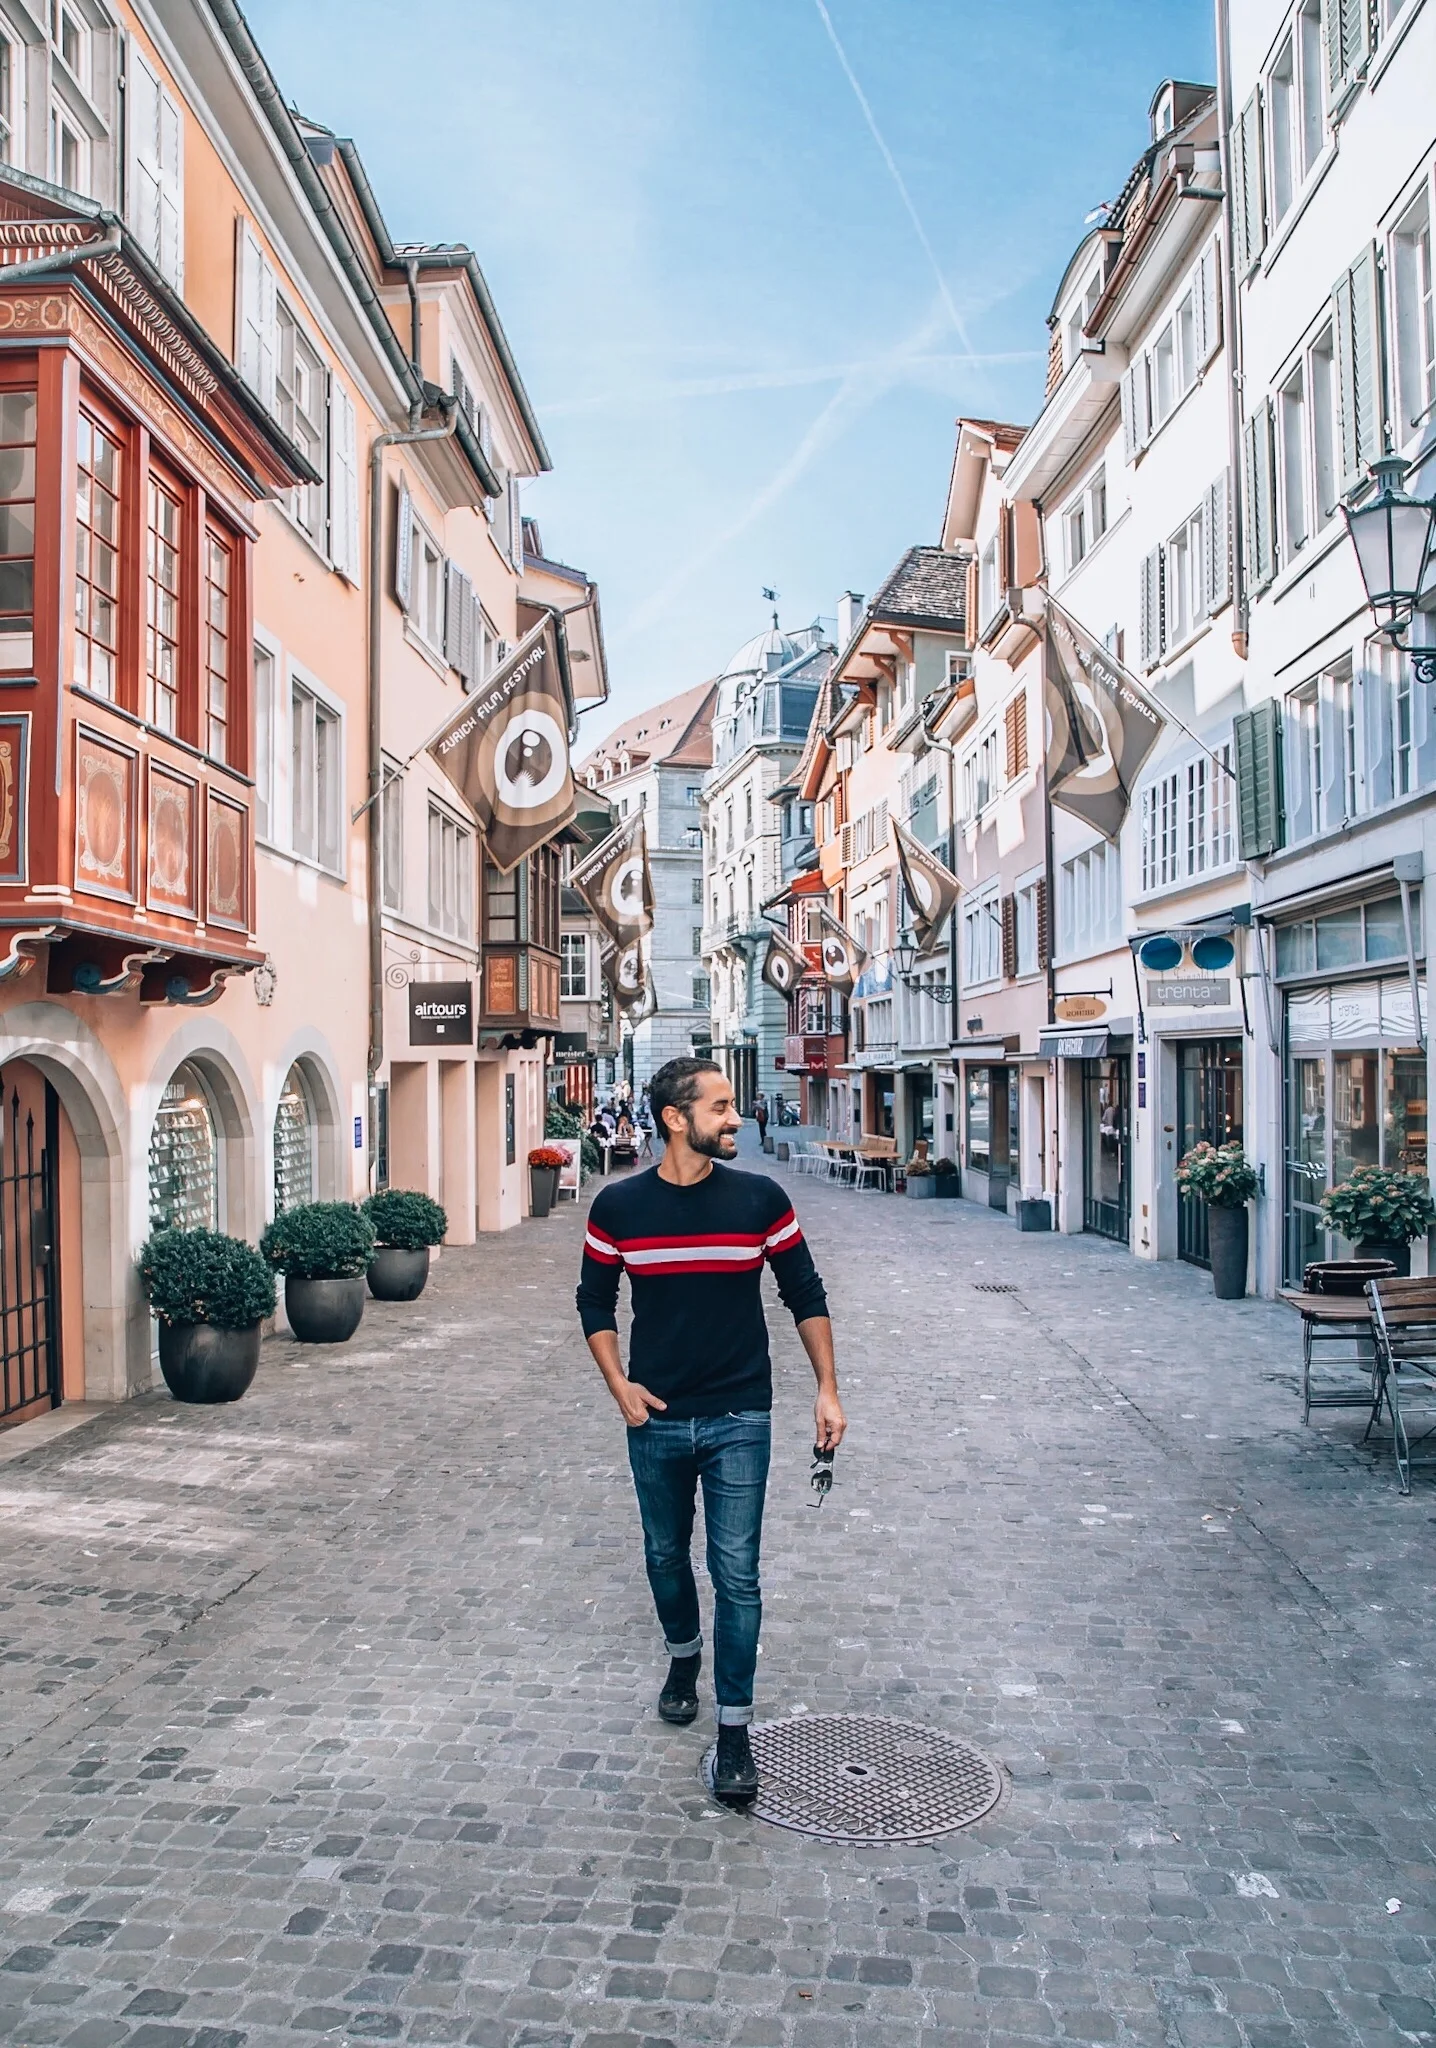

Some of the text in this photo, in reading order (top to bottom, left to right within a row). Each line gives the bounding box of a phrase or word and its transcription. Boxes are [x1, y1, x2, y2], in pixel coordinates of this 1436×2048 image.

[438, 645, 547, 756] ZURICH FILM FESTIVAL
[579, 863, 604, 886] ZURICH
[602, 847, 619, 865] FILM
[1156, 984, 1211, 999] trenta
[414, 1001, 467, 1016] airtours
[555, 1050, 586, 1058] meister
